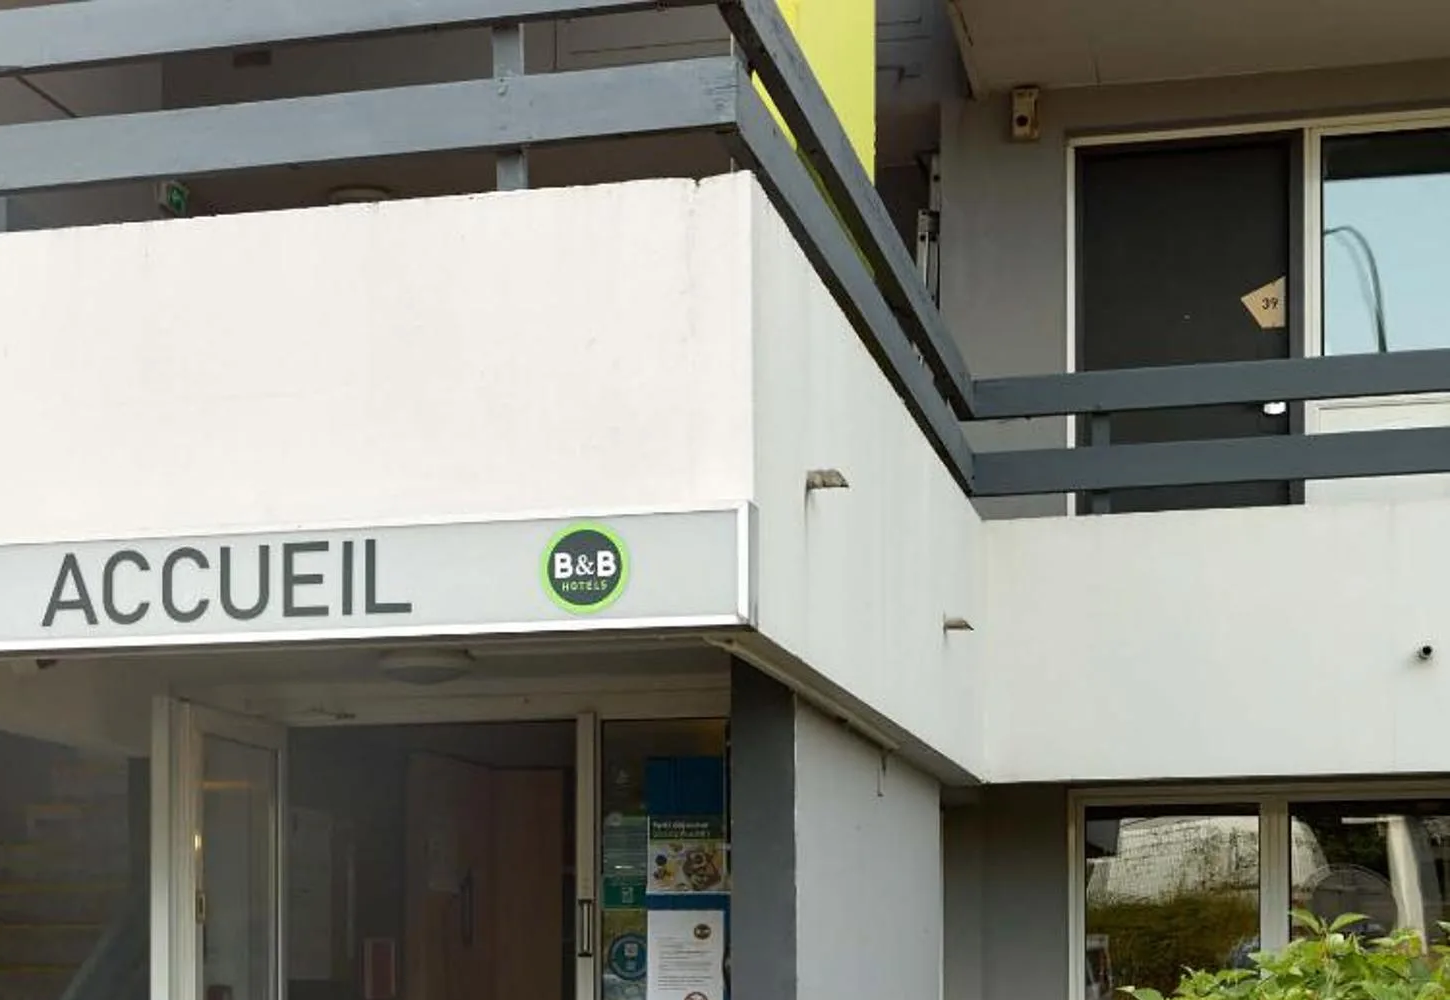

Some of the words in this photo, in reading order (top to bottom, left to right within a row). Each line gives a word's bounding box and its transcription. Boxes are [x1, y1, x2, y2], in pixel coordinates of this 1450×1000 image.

[1262, 297, 1279, 310] 39
[553, 549, 617, 579] B&B
[41, 538, 413, 627] ACCUEIL
[561, 579, 608, 592] HOTELS
